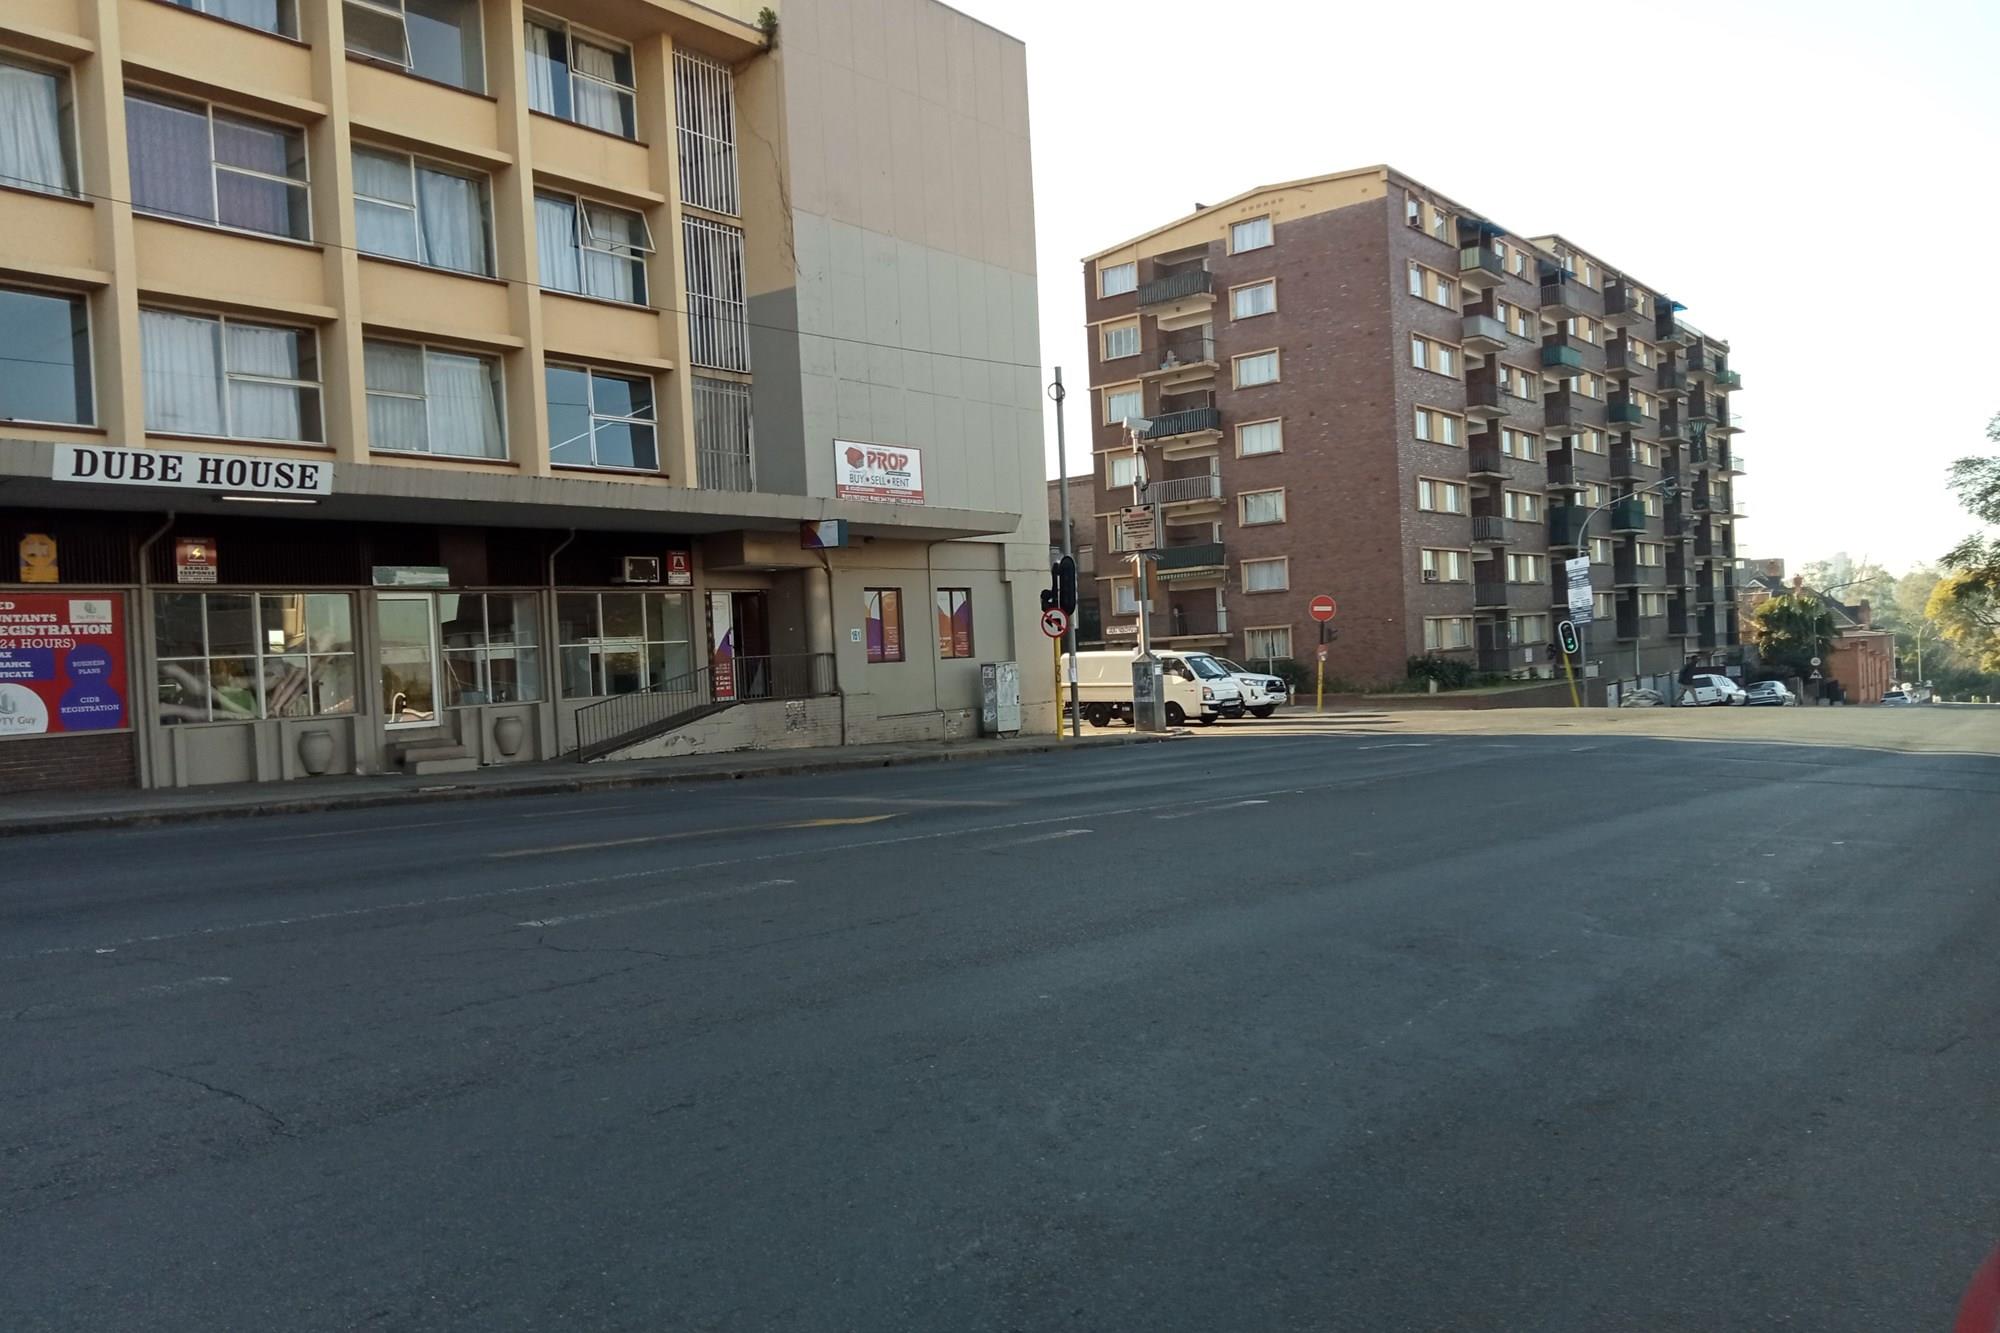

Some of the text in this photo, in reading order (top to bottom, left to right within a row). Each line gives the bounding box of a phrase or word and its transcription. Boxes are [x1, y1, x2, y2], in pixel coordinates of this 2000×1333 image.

[866, 451, 908, 471] PROP
[72, 449, 319, 490] DUBE HOUSE
[849, 473, 910, 487] BUY SELL RENT
[21, 638, 76, 650] HOURS)
[61, 704, 120, 714] REGISTRATION
